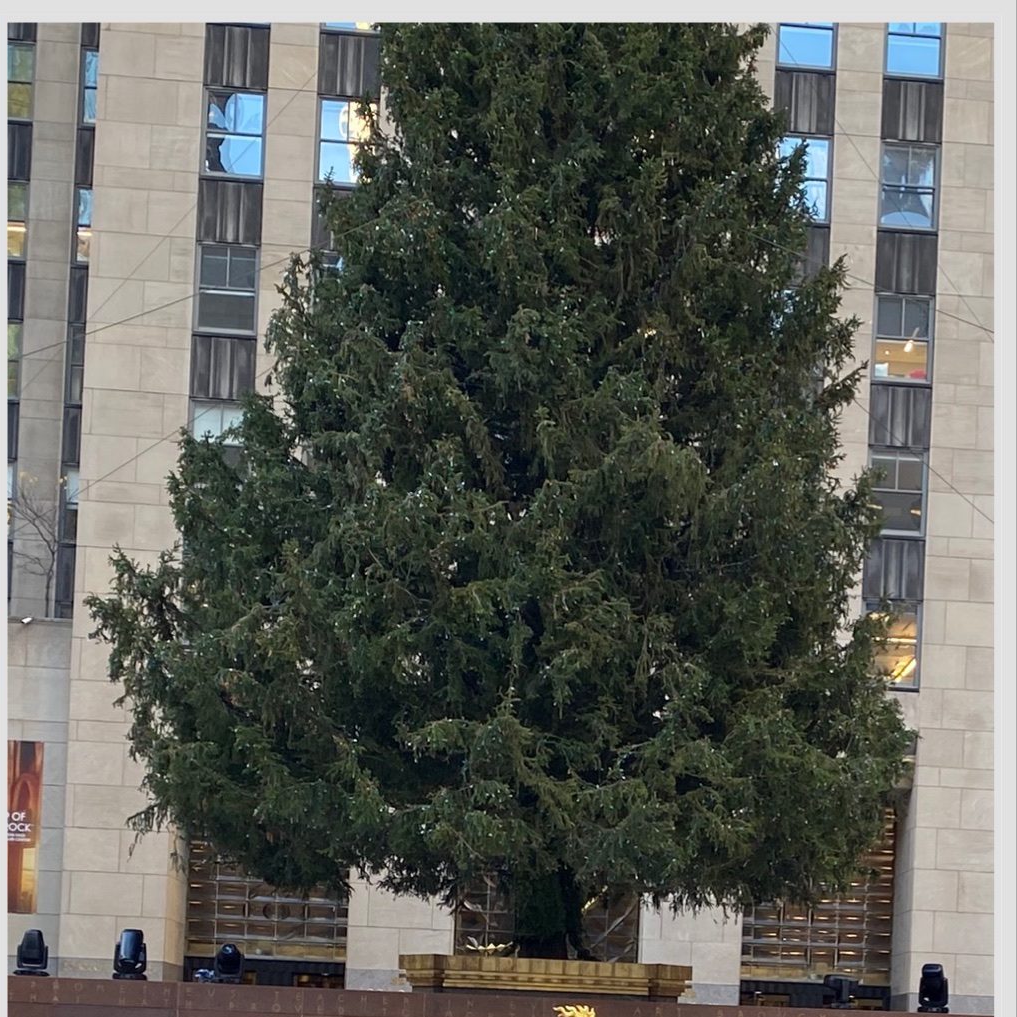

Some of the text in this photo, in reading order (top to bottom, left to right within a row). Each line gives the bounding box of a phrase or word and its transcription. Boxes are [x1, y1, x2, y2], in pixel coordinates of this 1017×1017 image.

[11, 811, 26, 821] OF
[7, 822, 31, 832] OCK
[275, 990, 410, 1007] TEACHER
